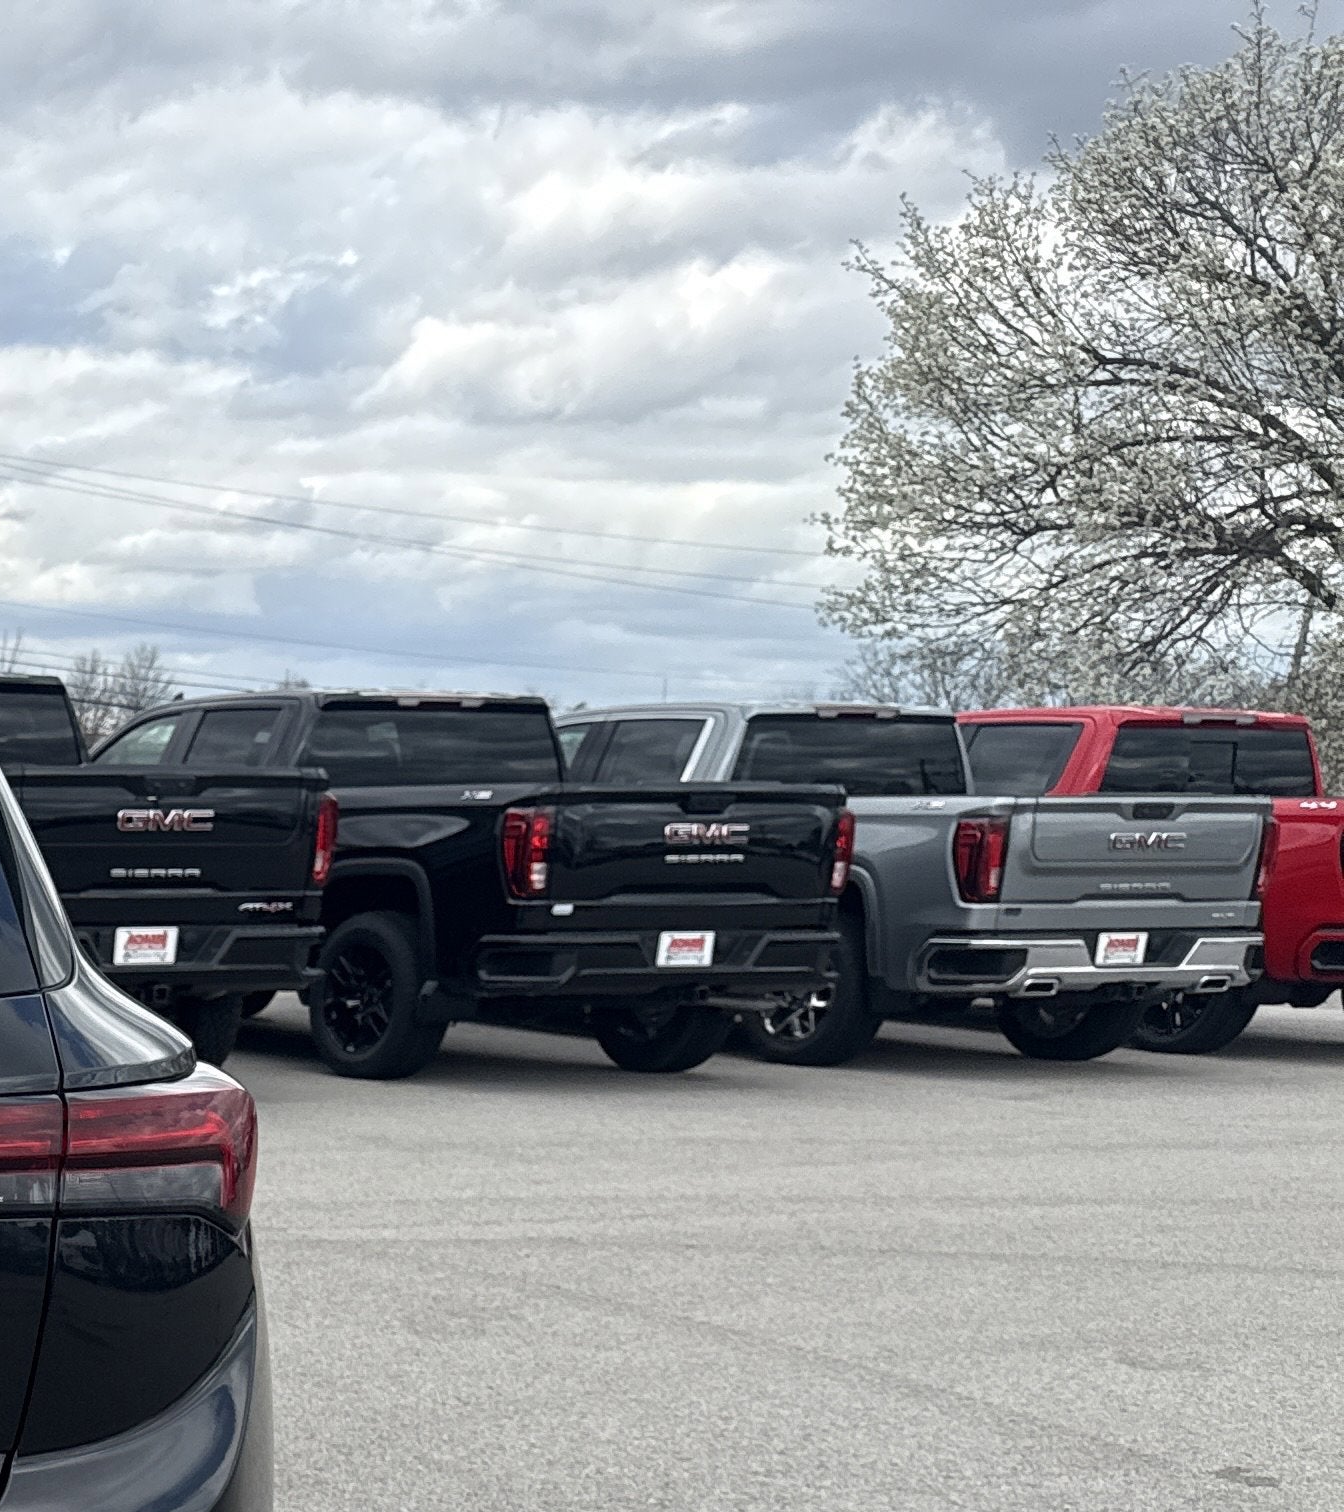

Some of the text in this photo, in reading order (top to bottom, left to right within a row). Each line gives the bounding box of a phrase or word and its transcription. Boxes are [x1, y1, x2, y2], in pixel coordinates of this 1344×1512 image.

[116, 809, 215, 832] GMC
[663, 822, 750, 845] GMC
[1109, 831, 1187, 851] GMC
